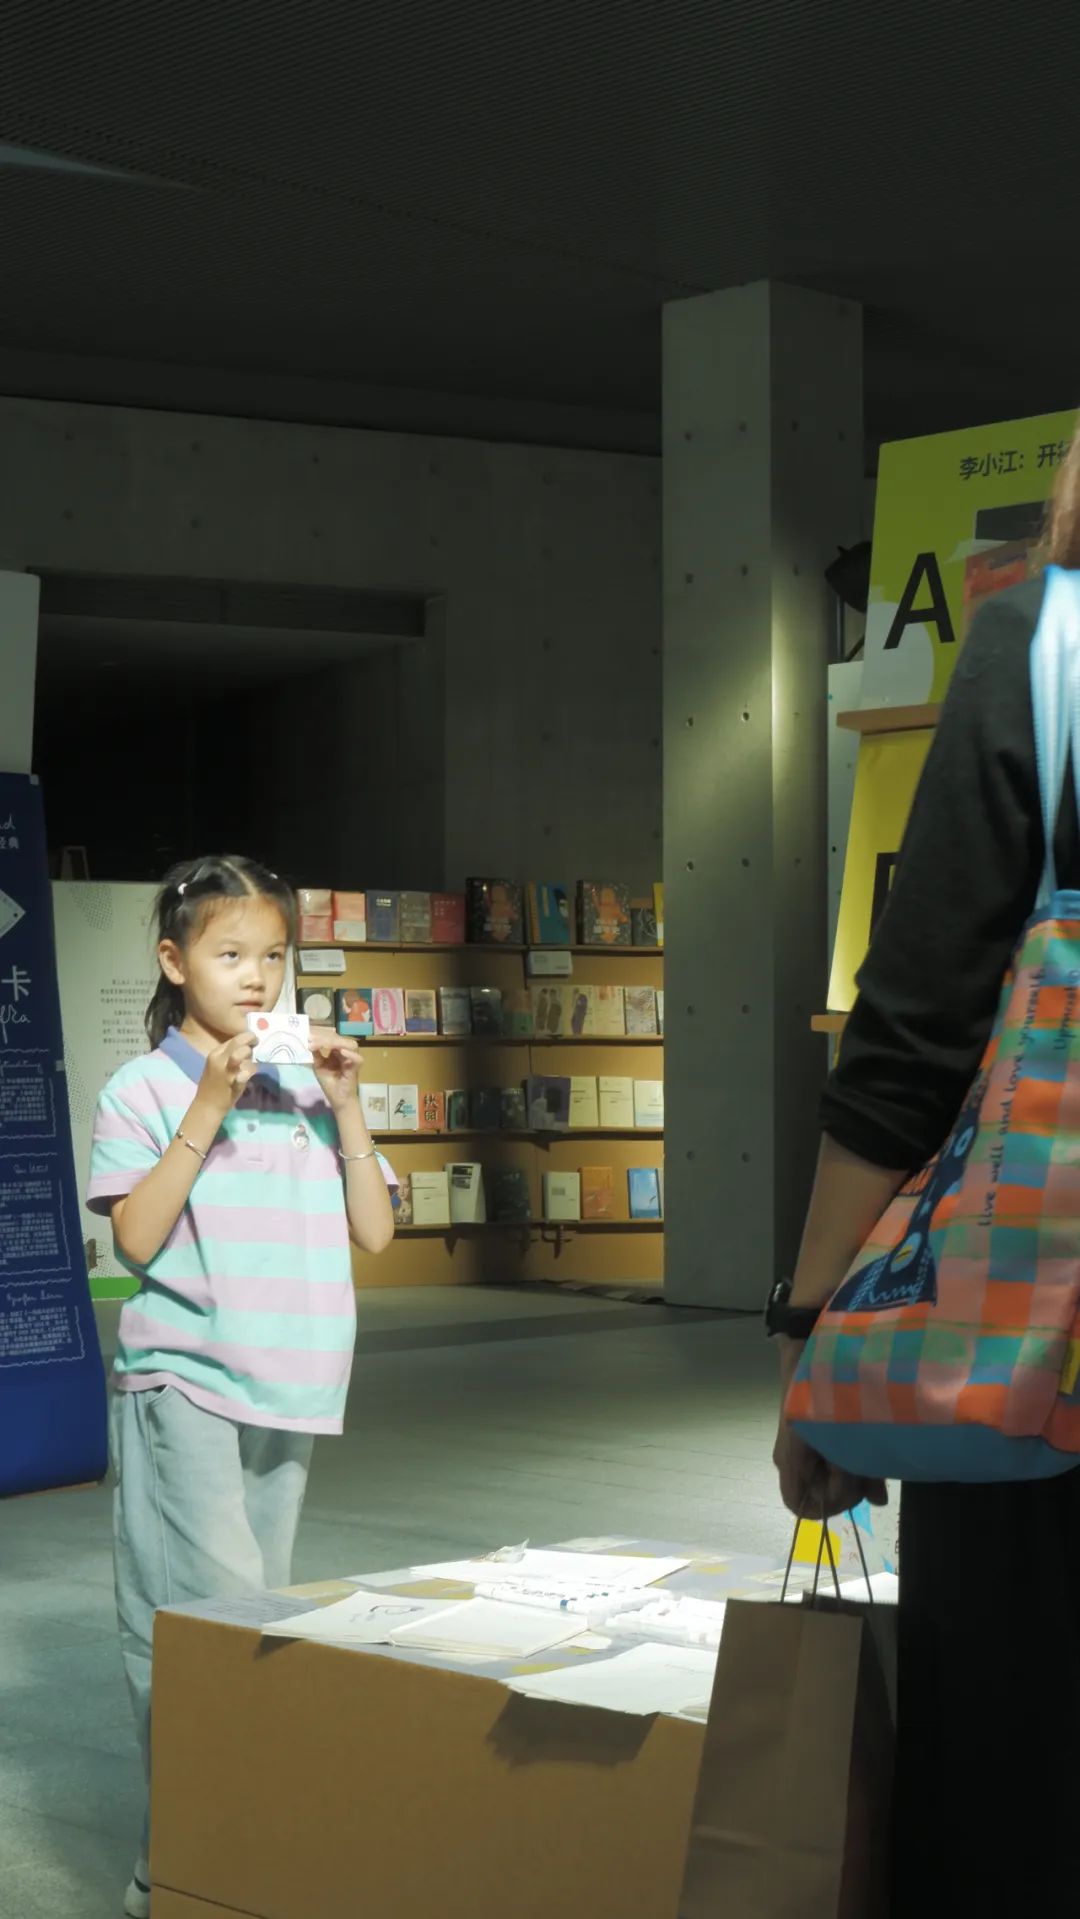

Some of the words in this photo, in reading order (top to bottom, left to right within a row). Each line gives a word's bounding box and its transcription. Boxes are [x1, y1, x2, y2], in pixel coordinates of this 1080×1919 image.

[883, 552, 955, 650] A
[1, 965, 32, 1001] 卡
[1003, 1053, 1024, 1092] love
[997, 1099, 1013, 1136] and
[987, 1144, 1005, 1184] well
